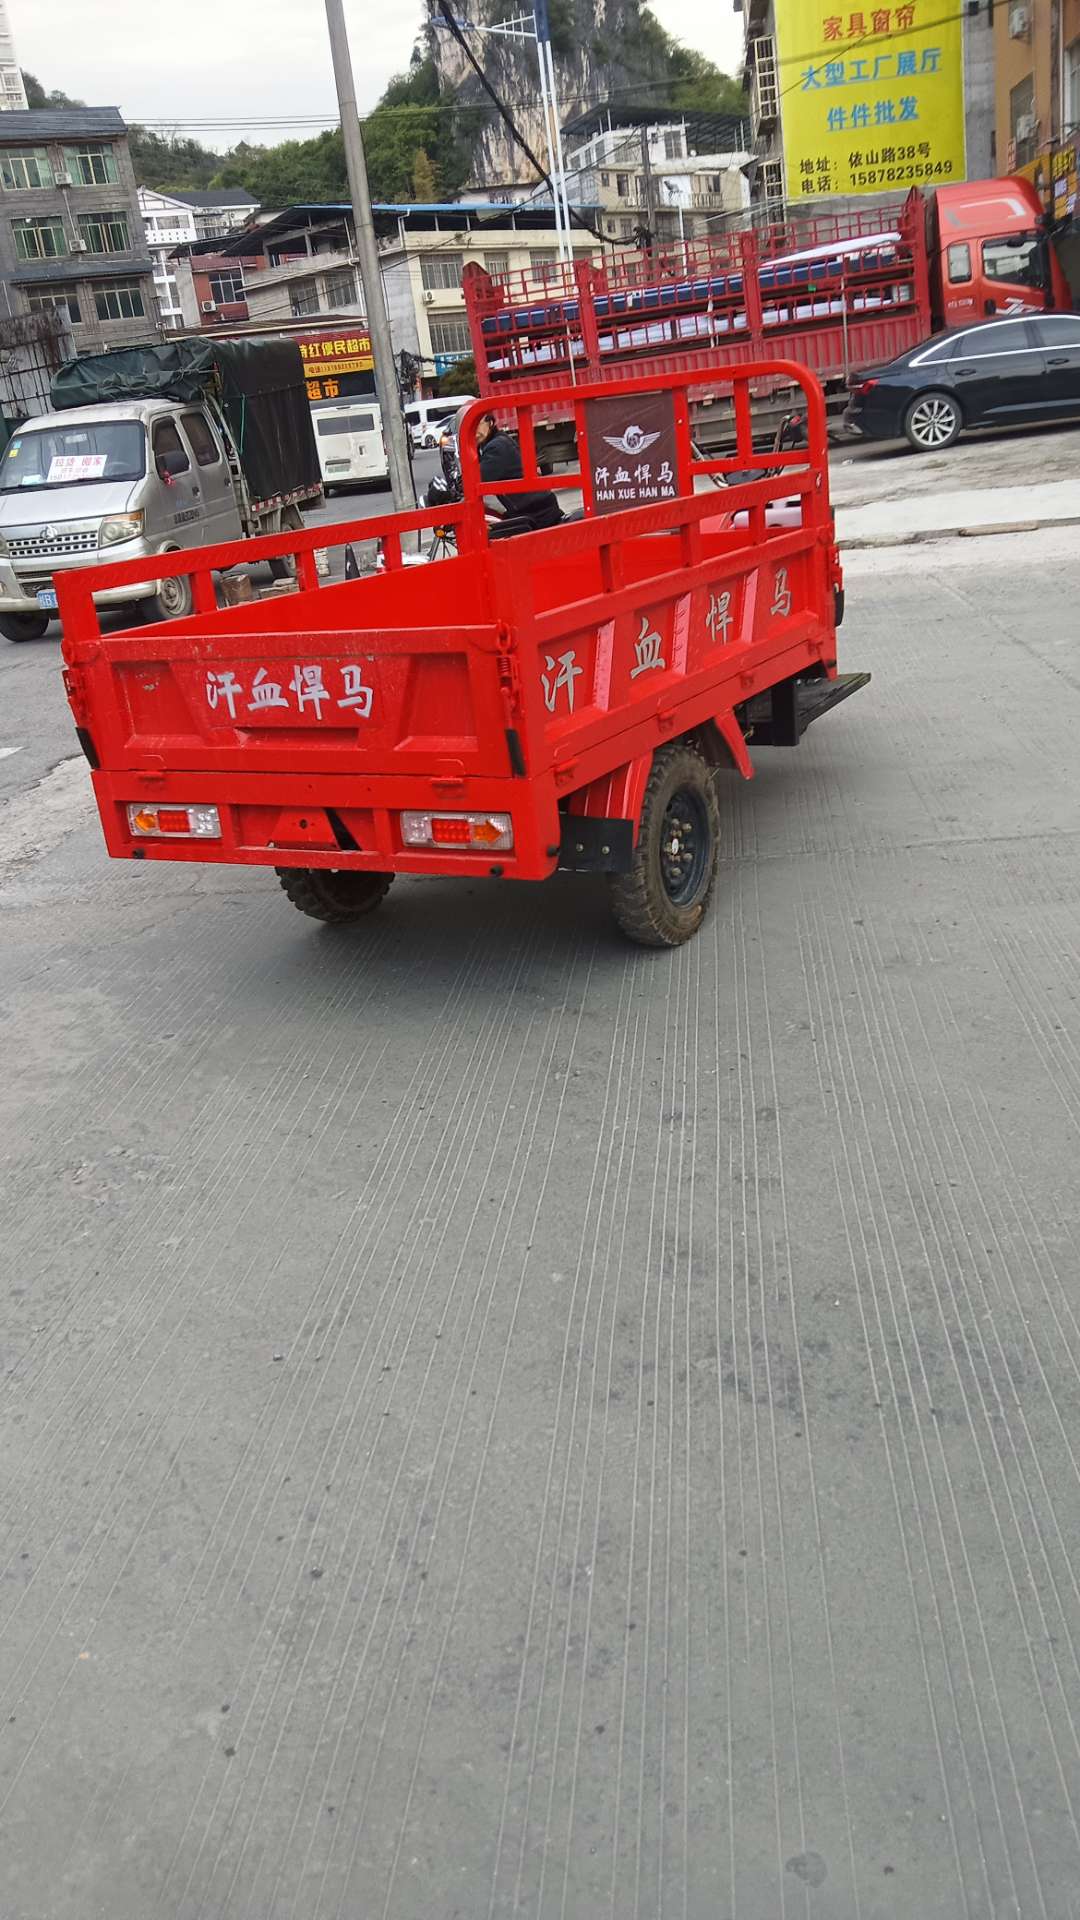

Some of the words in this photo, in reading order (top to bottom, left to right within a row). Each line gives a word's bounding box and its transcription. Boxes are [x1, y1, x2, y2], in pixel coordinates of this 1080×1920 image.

[823, 5, 916, 42] 家具窗帘
[801, 48, 942, 91] 大型工厂展厅
[827, 95, 919, 132] 件件批发
[595, 461, 674, 488] 汗血悍马
[597, 490, 615, 501] HAN
[618, 488, 636, 499] XUE
[639, 486, 658, 498] HAN
[661, 485, 676, 497] MA
[540, 567, 793, 716] 汗血悍马
[206, 664, 374, 721] 汗血悍马
